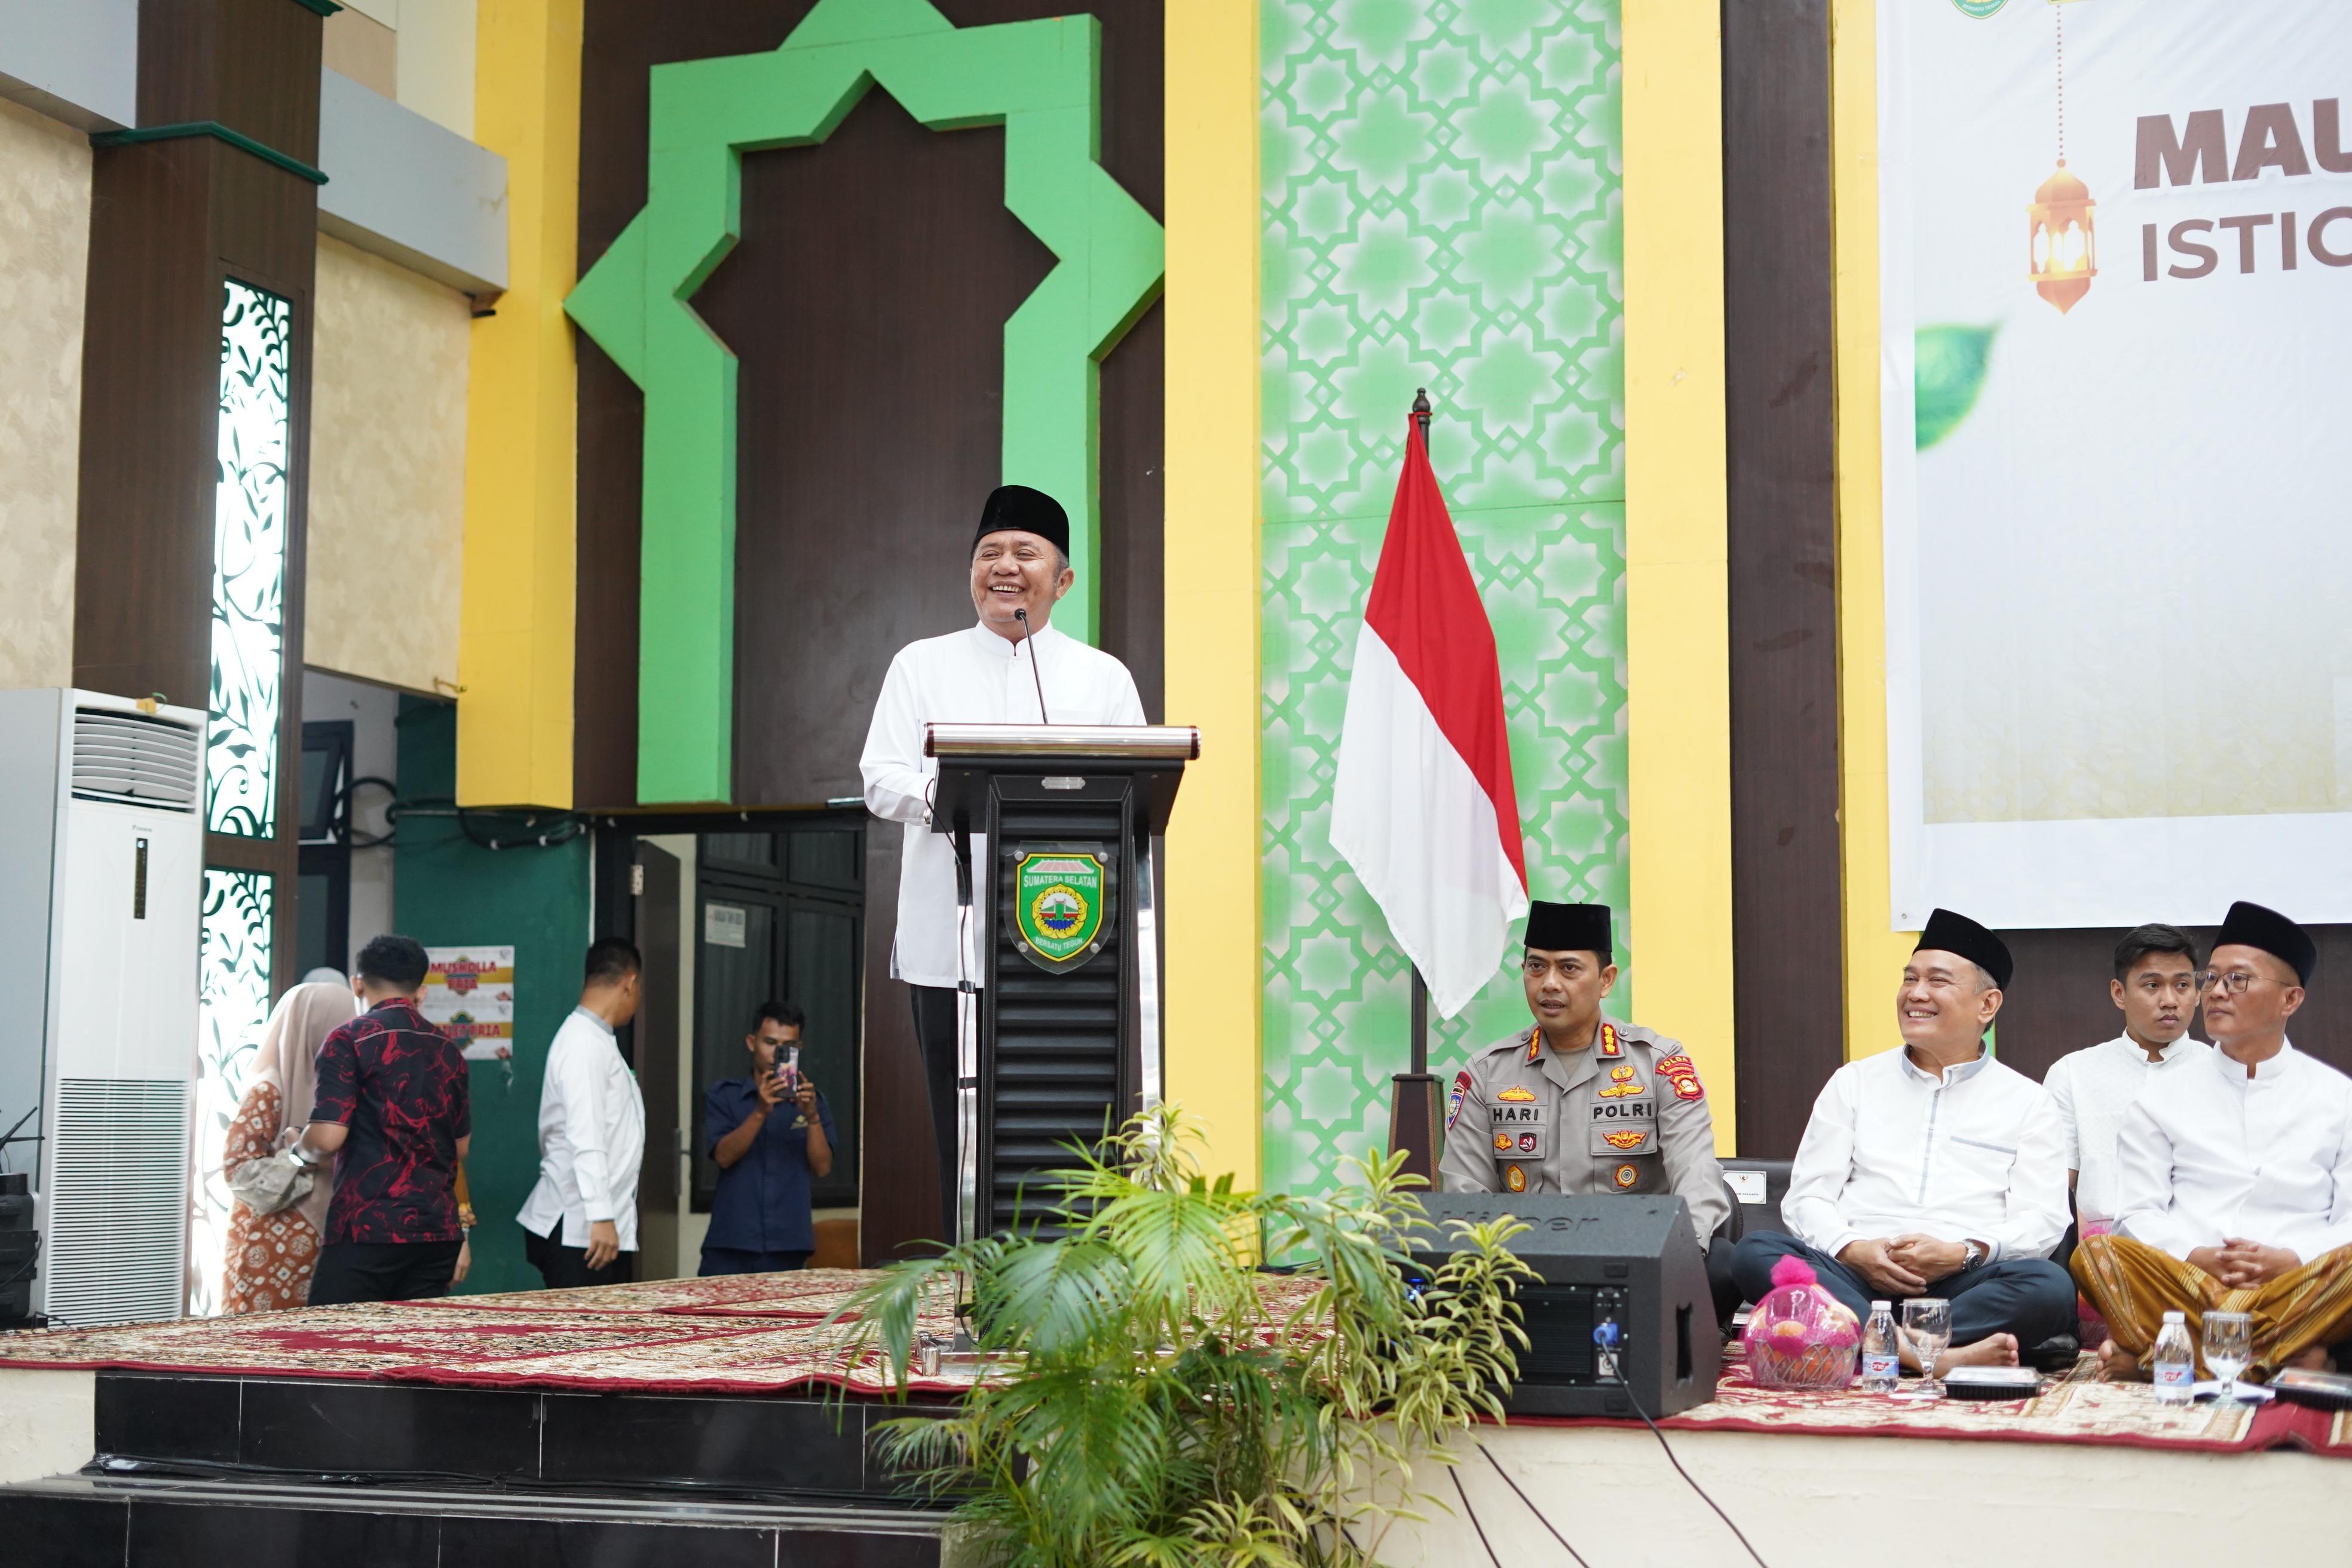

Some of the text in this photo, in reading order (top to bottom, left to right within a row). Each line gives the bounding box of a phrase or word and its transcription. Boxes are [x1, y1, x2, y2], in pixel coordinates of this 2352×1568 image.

[1024, 875, 1097, 889] SUMATERA SELATAN
[1035, 936, 1083, 951] BERSATU TEGUH
[430, 961, 497, 974] MUSHOLLA
[448, 978, 478, 990] PRIA
[470, 1023, 501, 1036] PRIA
[1659, 1056, 1689, 1071] POLDA
[1493, 1107, 1539, 1122] HARI
[1593, 1102, 1652, 1119] POLRI
